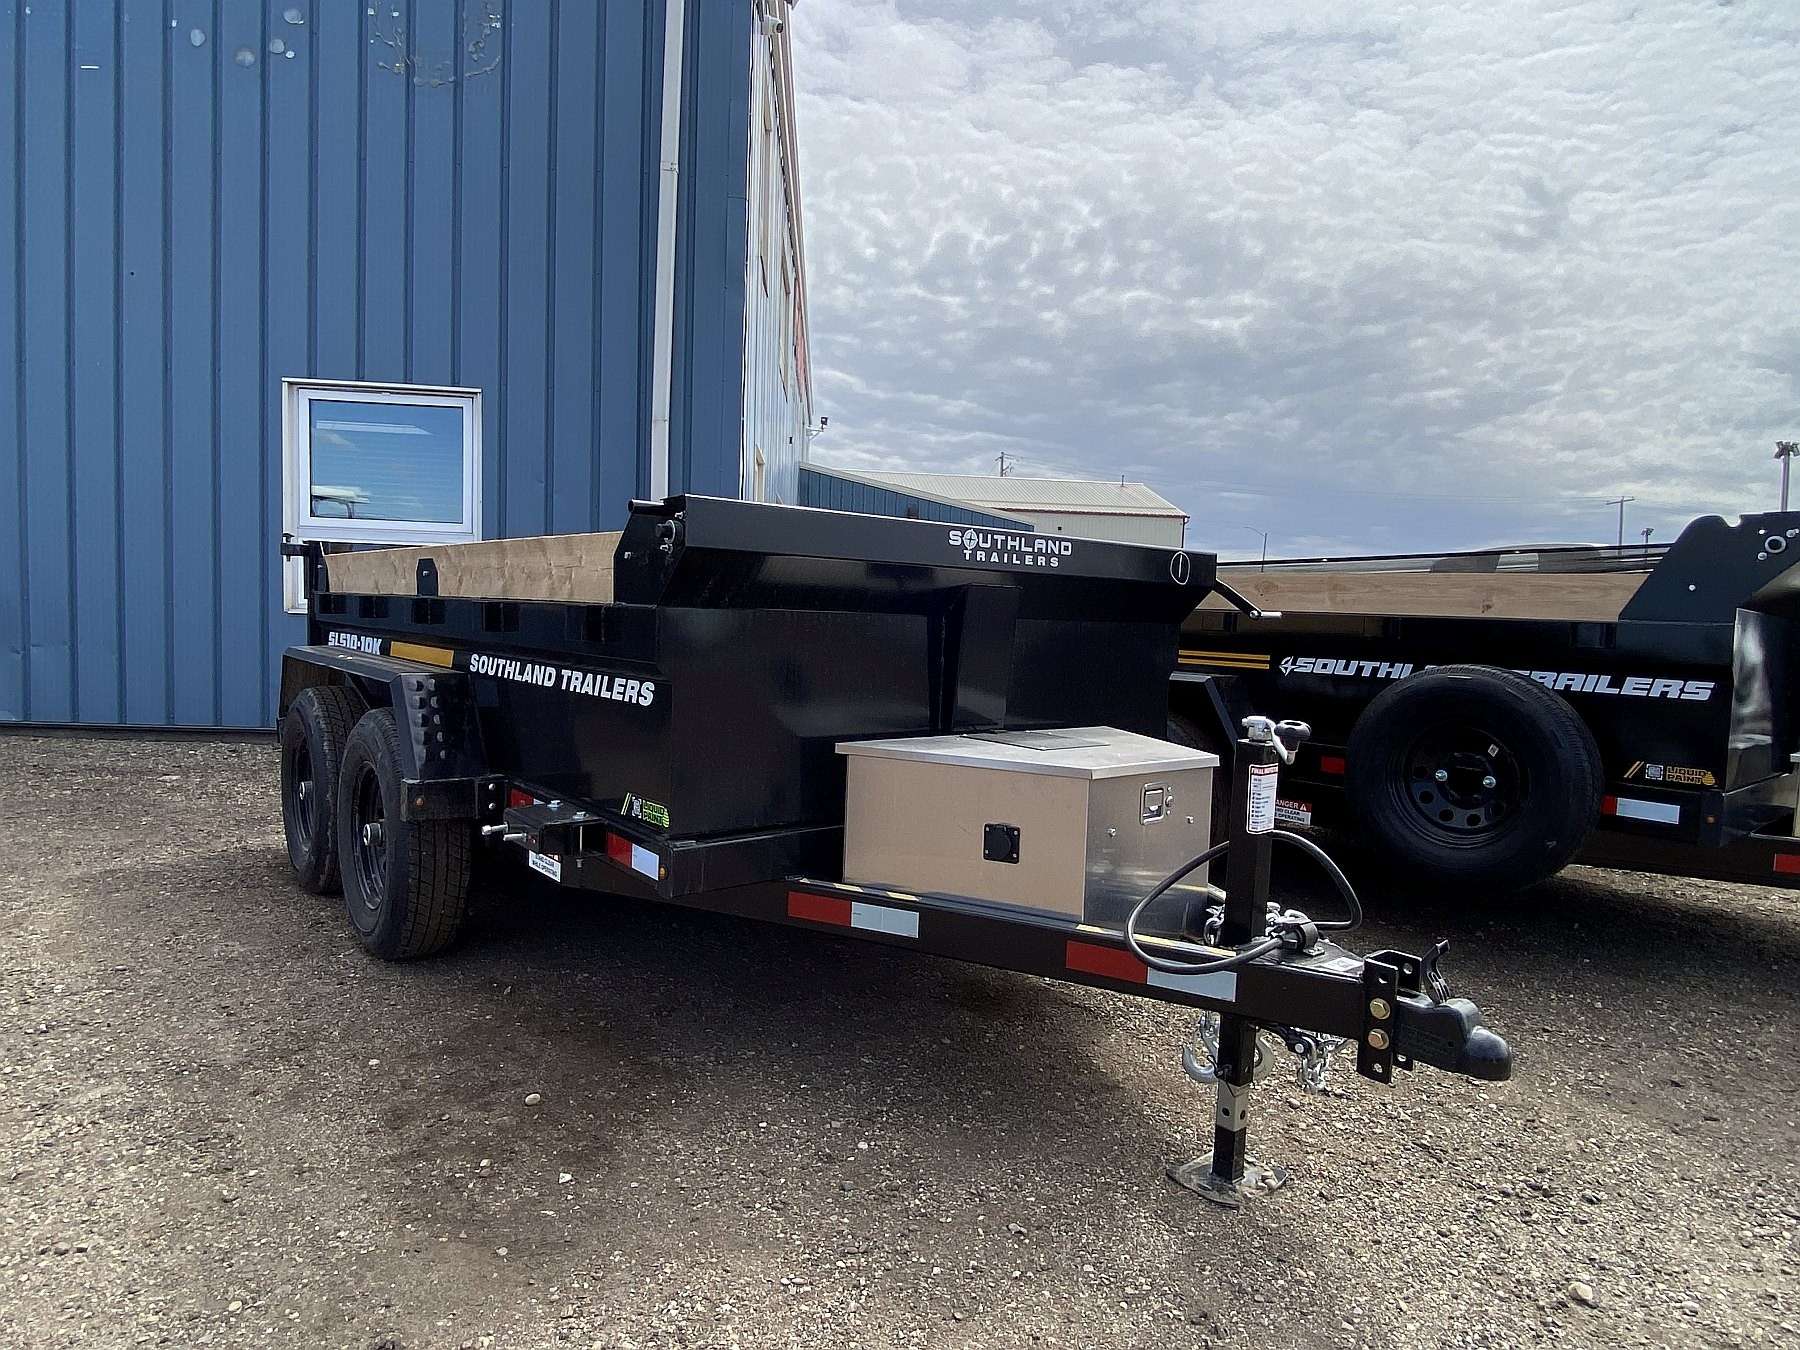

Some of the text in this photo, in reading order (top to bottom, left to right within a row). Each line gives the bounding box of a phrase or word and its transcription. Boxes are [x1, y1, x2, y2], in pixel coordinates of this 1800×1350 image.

[948, 529, 1073, 556] SOUTHLAND
[963, 549, 1060, 568] TRAILERS
[469, 653, 655, 707] SOUTHLAND TRAILERS
[1511, 669, 1716, 701] RAILERS
[1666, 773, 1702, 785] PAINT
[1276, 799, 1299, 810] ANGER
